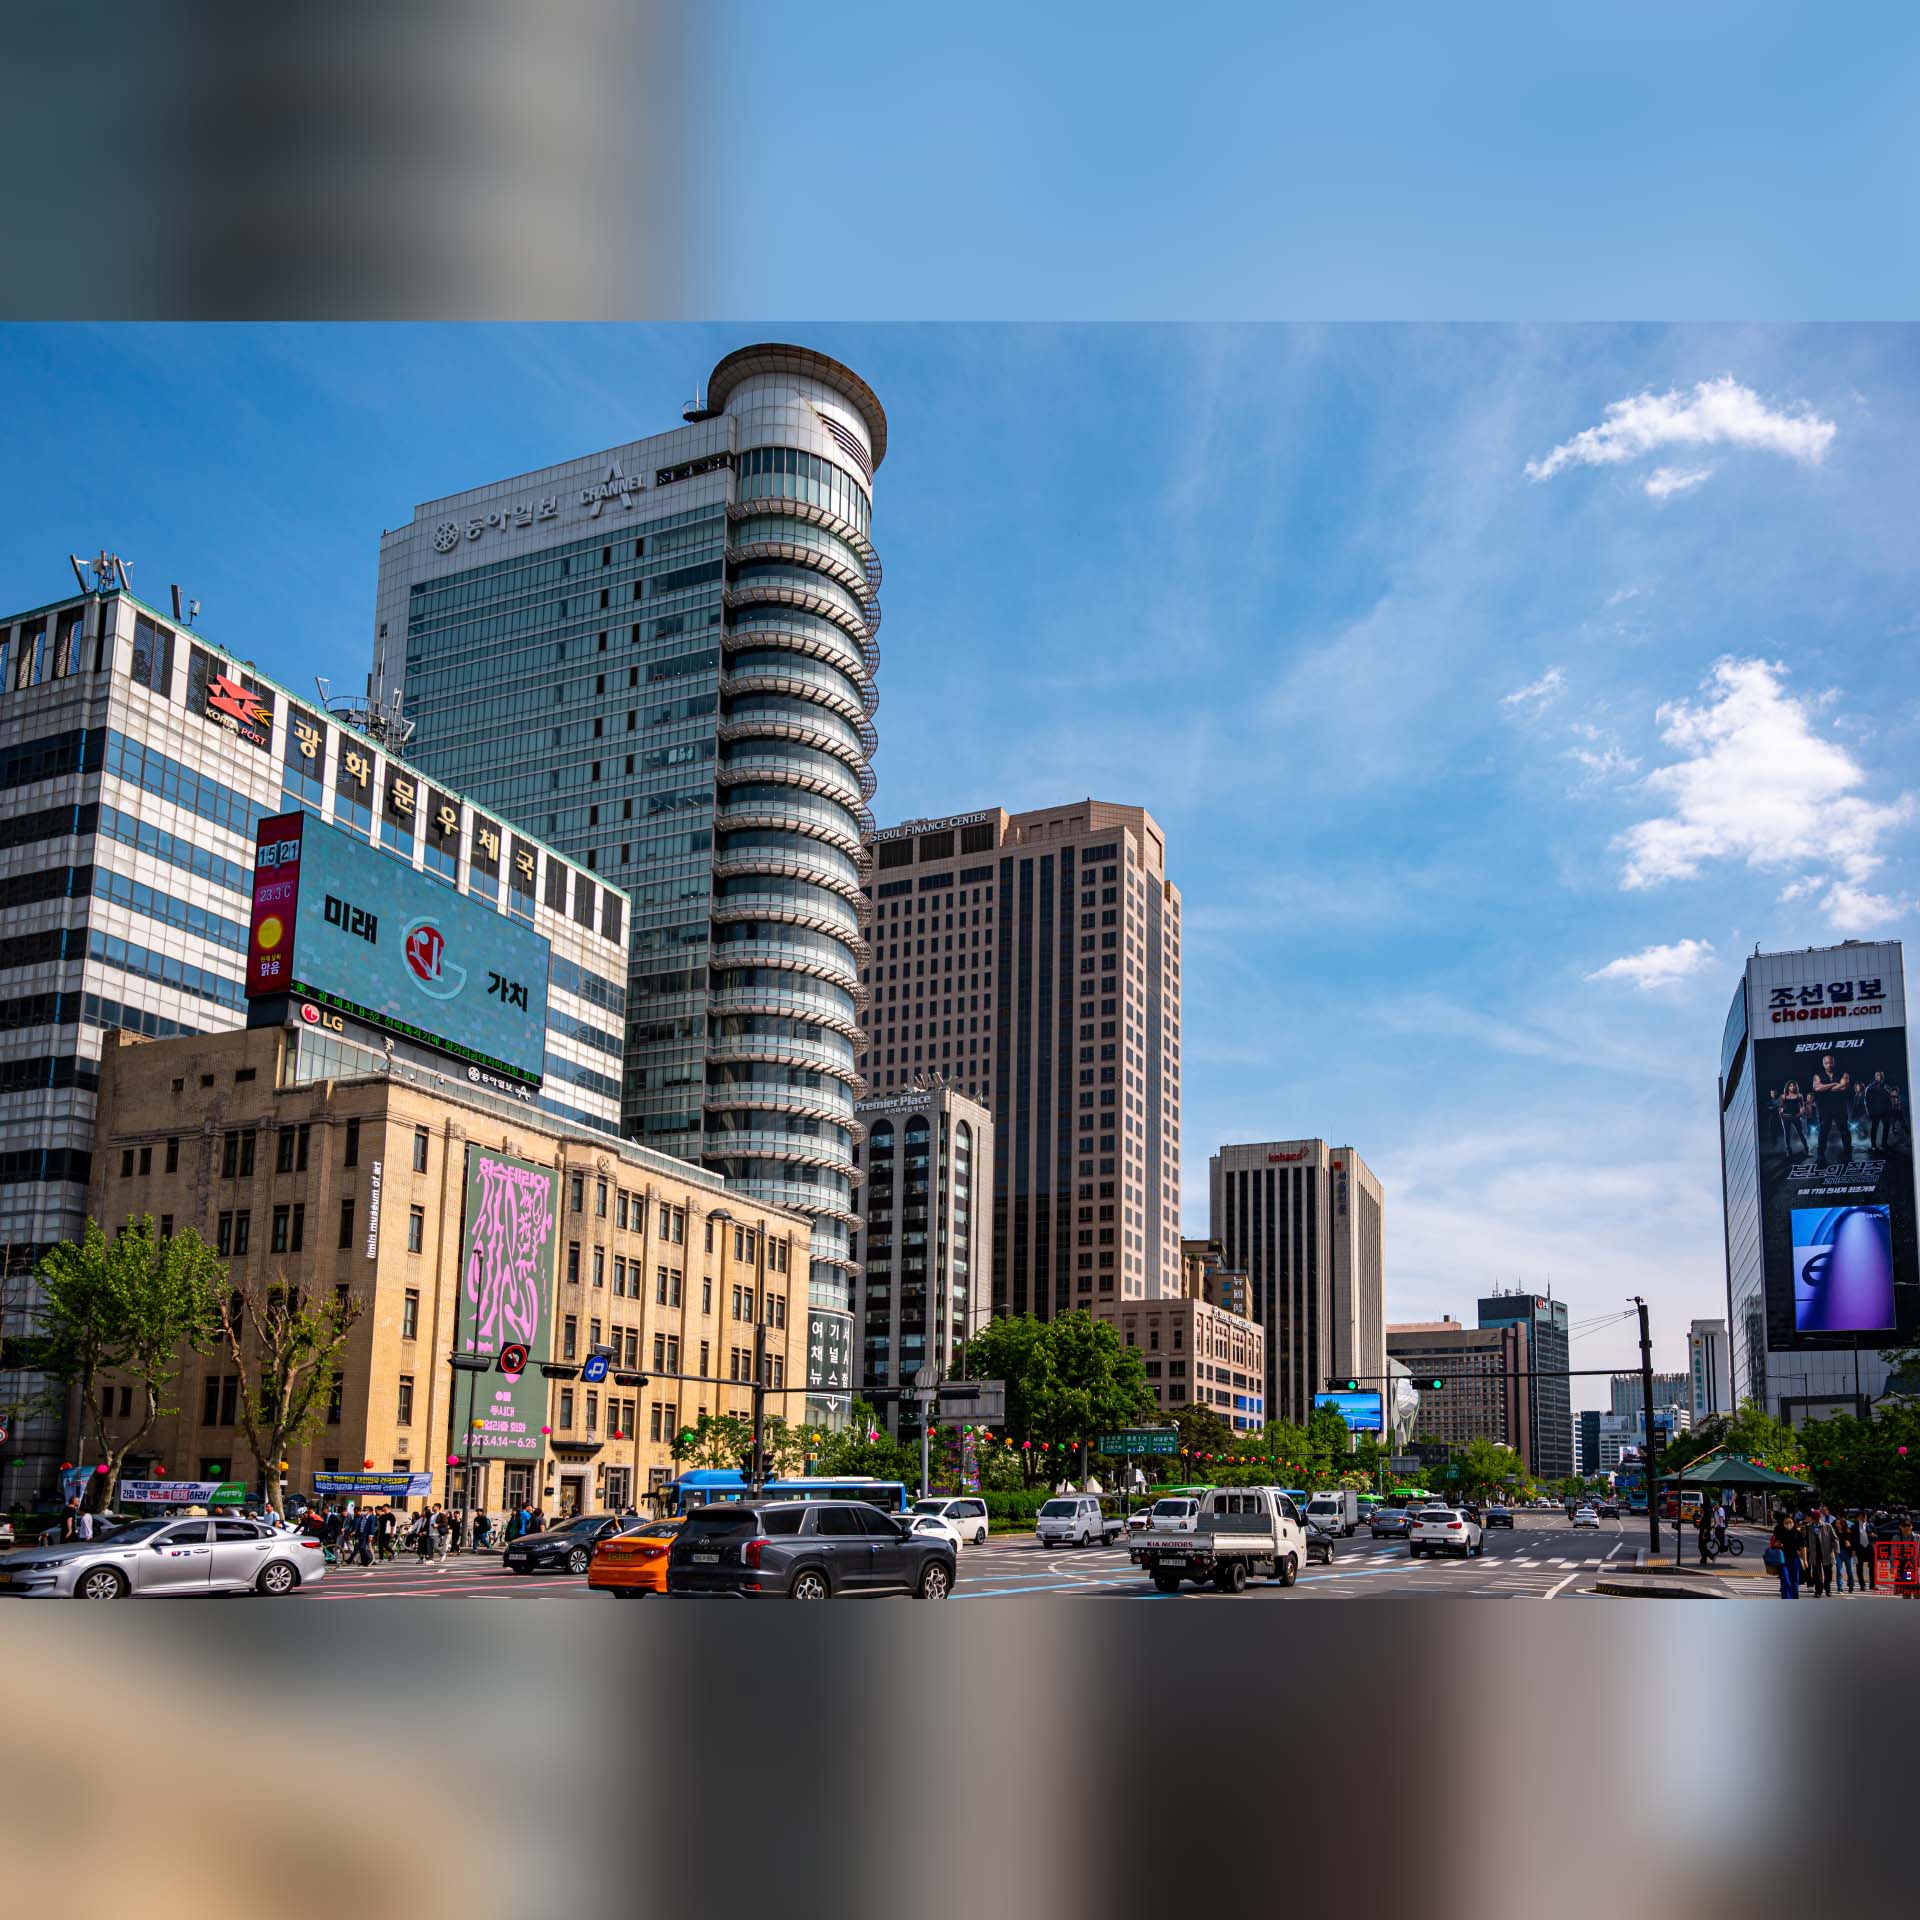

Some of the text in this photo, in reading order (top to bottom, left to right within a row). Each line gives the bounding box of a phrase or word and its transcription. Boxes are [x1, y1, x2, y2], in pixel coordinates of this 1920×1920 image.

[581, 474, 645, 504] CHANNEL
[464, 495, 560, 540] 동아일보
[241, 727, 265, 745] POST
[871, 812, 986, 842] SEOUL FINANCE CENTER
[324, 894, 378, 945] 미래
[261, 961, 281, 977] 맑음
[487, 971, 528, 1012] 가치
[1769, 978, 1887, 1009] 조선일보
[322, 1011, 344, 1033] LG
[1772, 1004, 1882, 1023] chosun.com
[1795, 1042, 1832, 1053] 달리거나
[481, 1073, 513, 1092] 동아일보
[855, 1095, 931, 1112] Premier Place
[371, 1161, 381, 1174] art
[371, 1176, 380, 1188] of
[370, 1189, 379, 1231] museum
[490, 1405, 515, 1417] 동시대
[481, 1420, 509, 1432] 얼리즘
